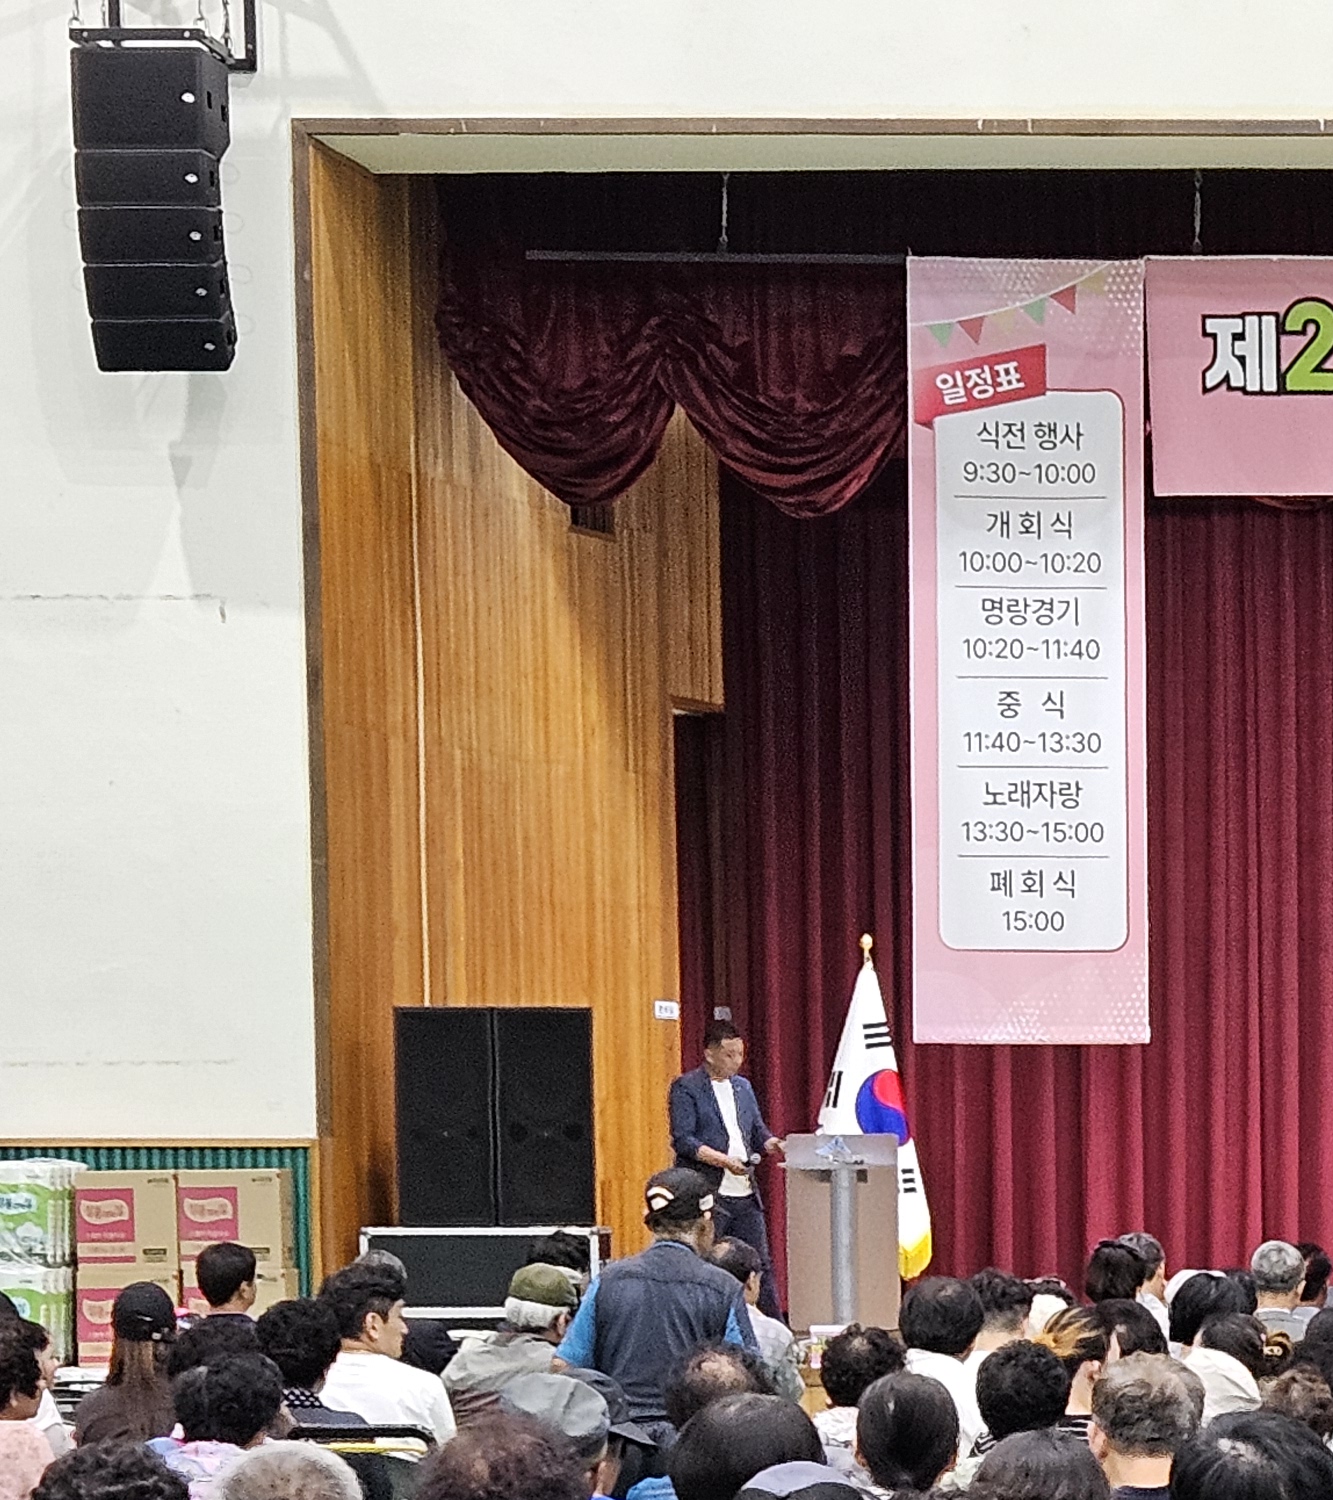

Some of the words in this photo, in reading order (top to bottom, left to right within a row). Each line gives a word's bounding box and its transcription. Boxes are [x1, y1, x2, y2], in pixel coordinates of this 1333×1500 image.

[935, 360, 1025, 406] 일정표
[976, 421, 1026, 451] 식전
[1033, 421, 1084, 451] 행사
[962, 461, 1097, 484] 9:30~10:00
[958, 551, 1102, 574] 10:00~10:20
[980, 597, 1081, 627] 명랑경기
[962, 638, 1101, 660] 10:20~11:40
[963, 731, 1103, 754] 11:40~13:30
[982, 780, 1084, 809] 노래자랑
[961, 821, 1105, 844] 13:30~15:00
[1001, 910, 1066, 932] 15:00
